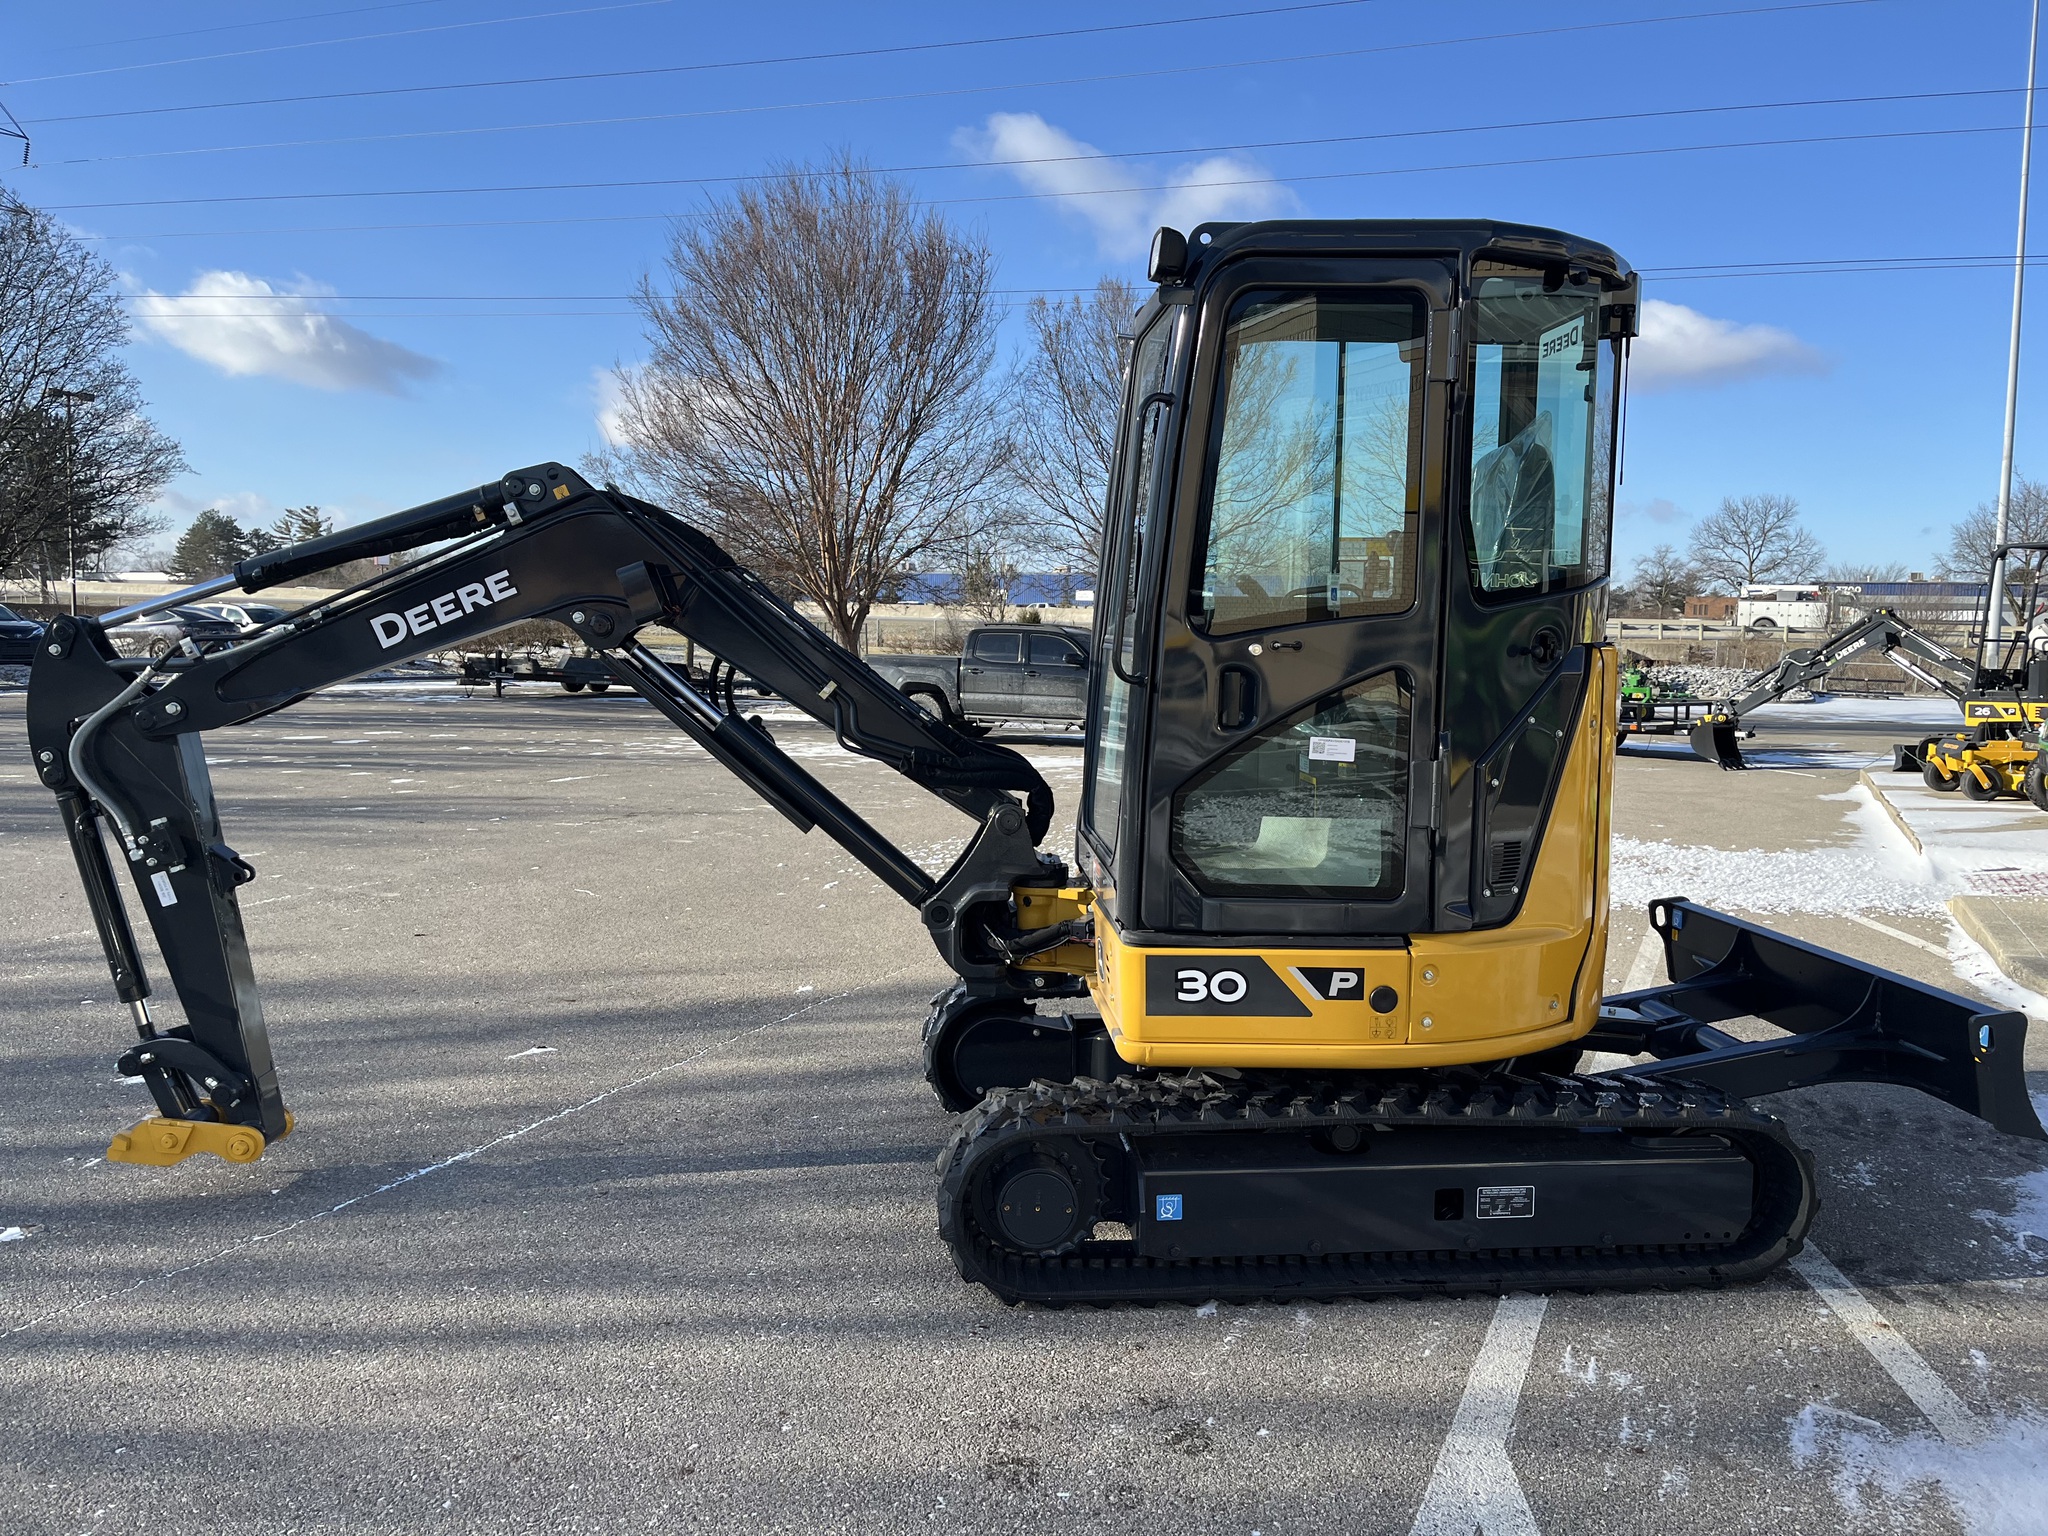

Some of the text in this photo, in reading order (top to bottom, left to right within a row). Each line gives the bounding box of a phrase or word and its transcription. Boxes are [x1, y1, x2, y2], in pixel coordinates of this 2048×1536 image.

[369, 569, 518, 649] DEERE
[1835, 637, 1867, 660] DEERE
[1974, 707, 1990, 715] 26
[1176, 969, 1358, 1002] 30 P
